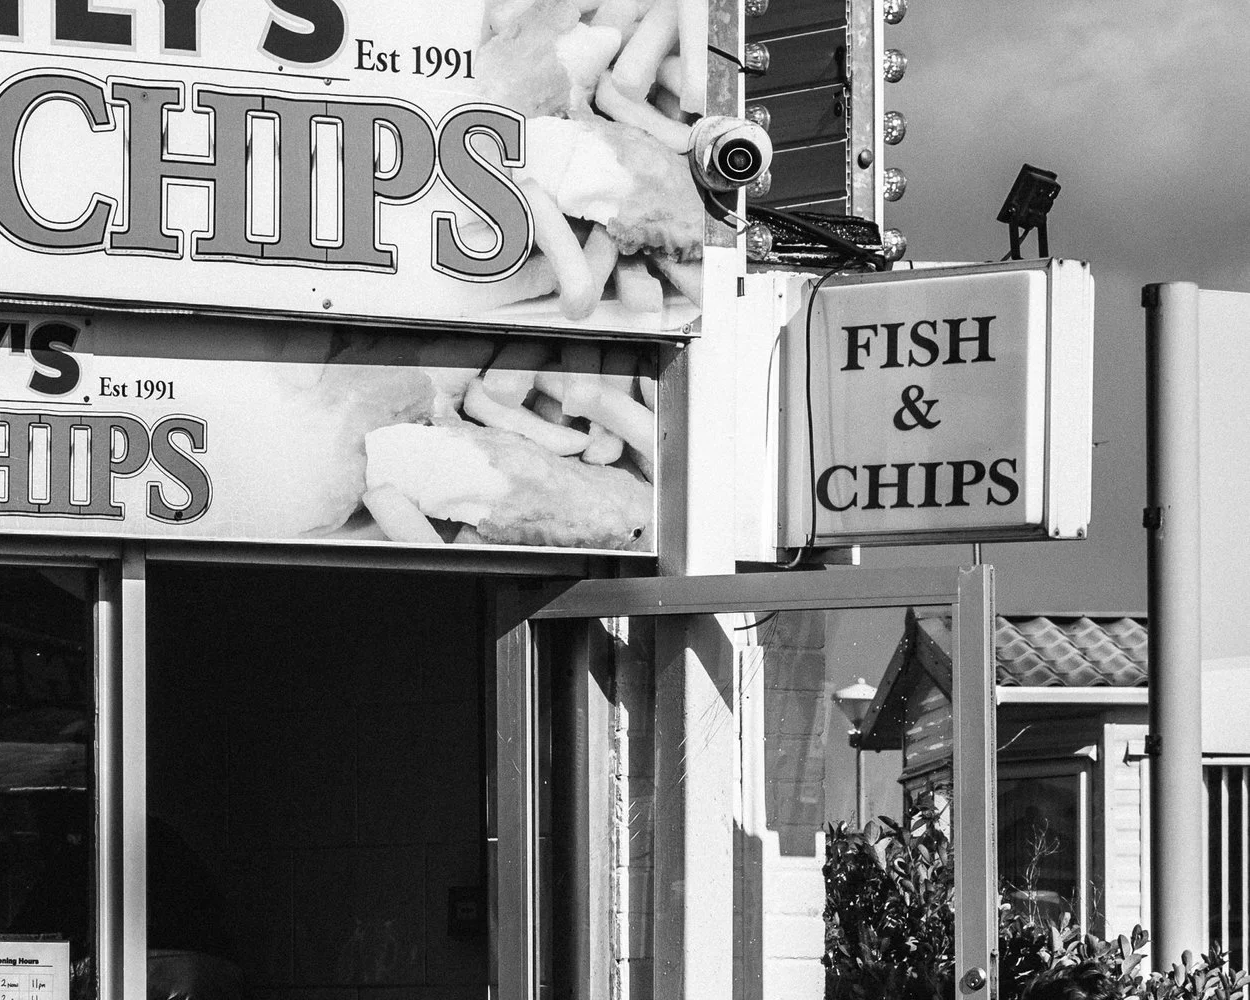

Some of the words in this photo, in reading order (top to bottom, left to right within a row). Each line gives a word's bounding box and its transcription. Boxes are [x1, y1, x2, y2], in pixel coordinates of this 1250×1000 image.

[355, 40, 398, 73] Est
[412, 46, 476, 80] 1991
[840, 315, 997, 372] FISH
[99, 377, 128, 398] Est
[135, 380, 175, 400] 1991
[893, 384, 941, 432] &
[816, 457, 1019, 512] CHIPS
